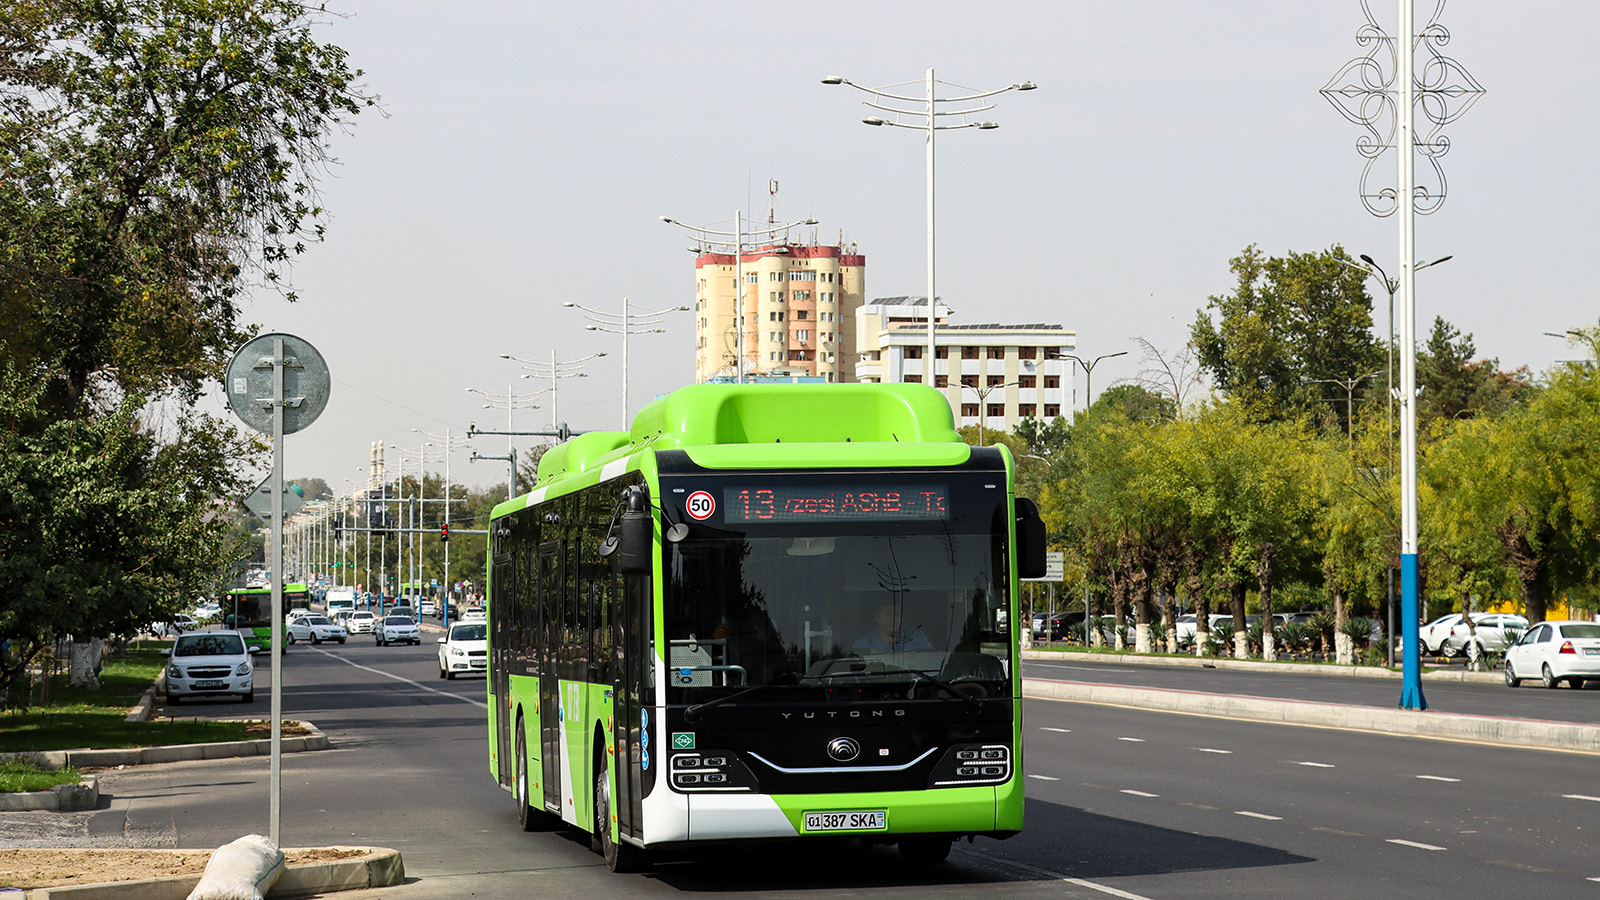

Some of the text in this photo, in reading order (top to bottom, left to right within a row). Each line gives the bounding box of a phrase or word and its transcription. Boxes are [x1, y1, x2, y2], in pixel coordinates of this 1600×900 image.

[692, 499, 710, 512] 50
[739, 490, 775, 519] 13
[781, 709, 905, 719] YUTONG
[823, 814, 847, 828] 387
[850, 813, 877, 827] SKA
